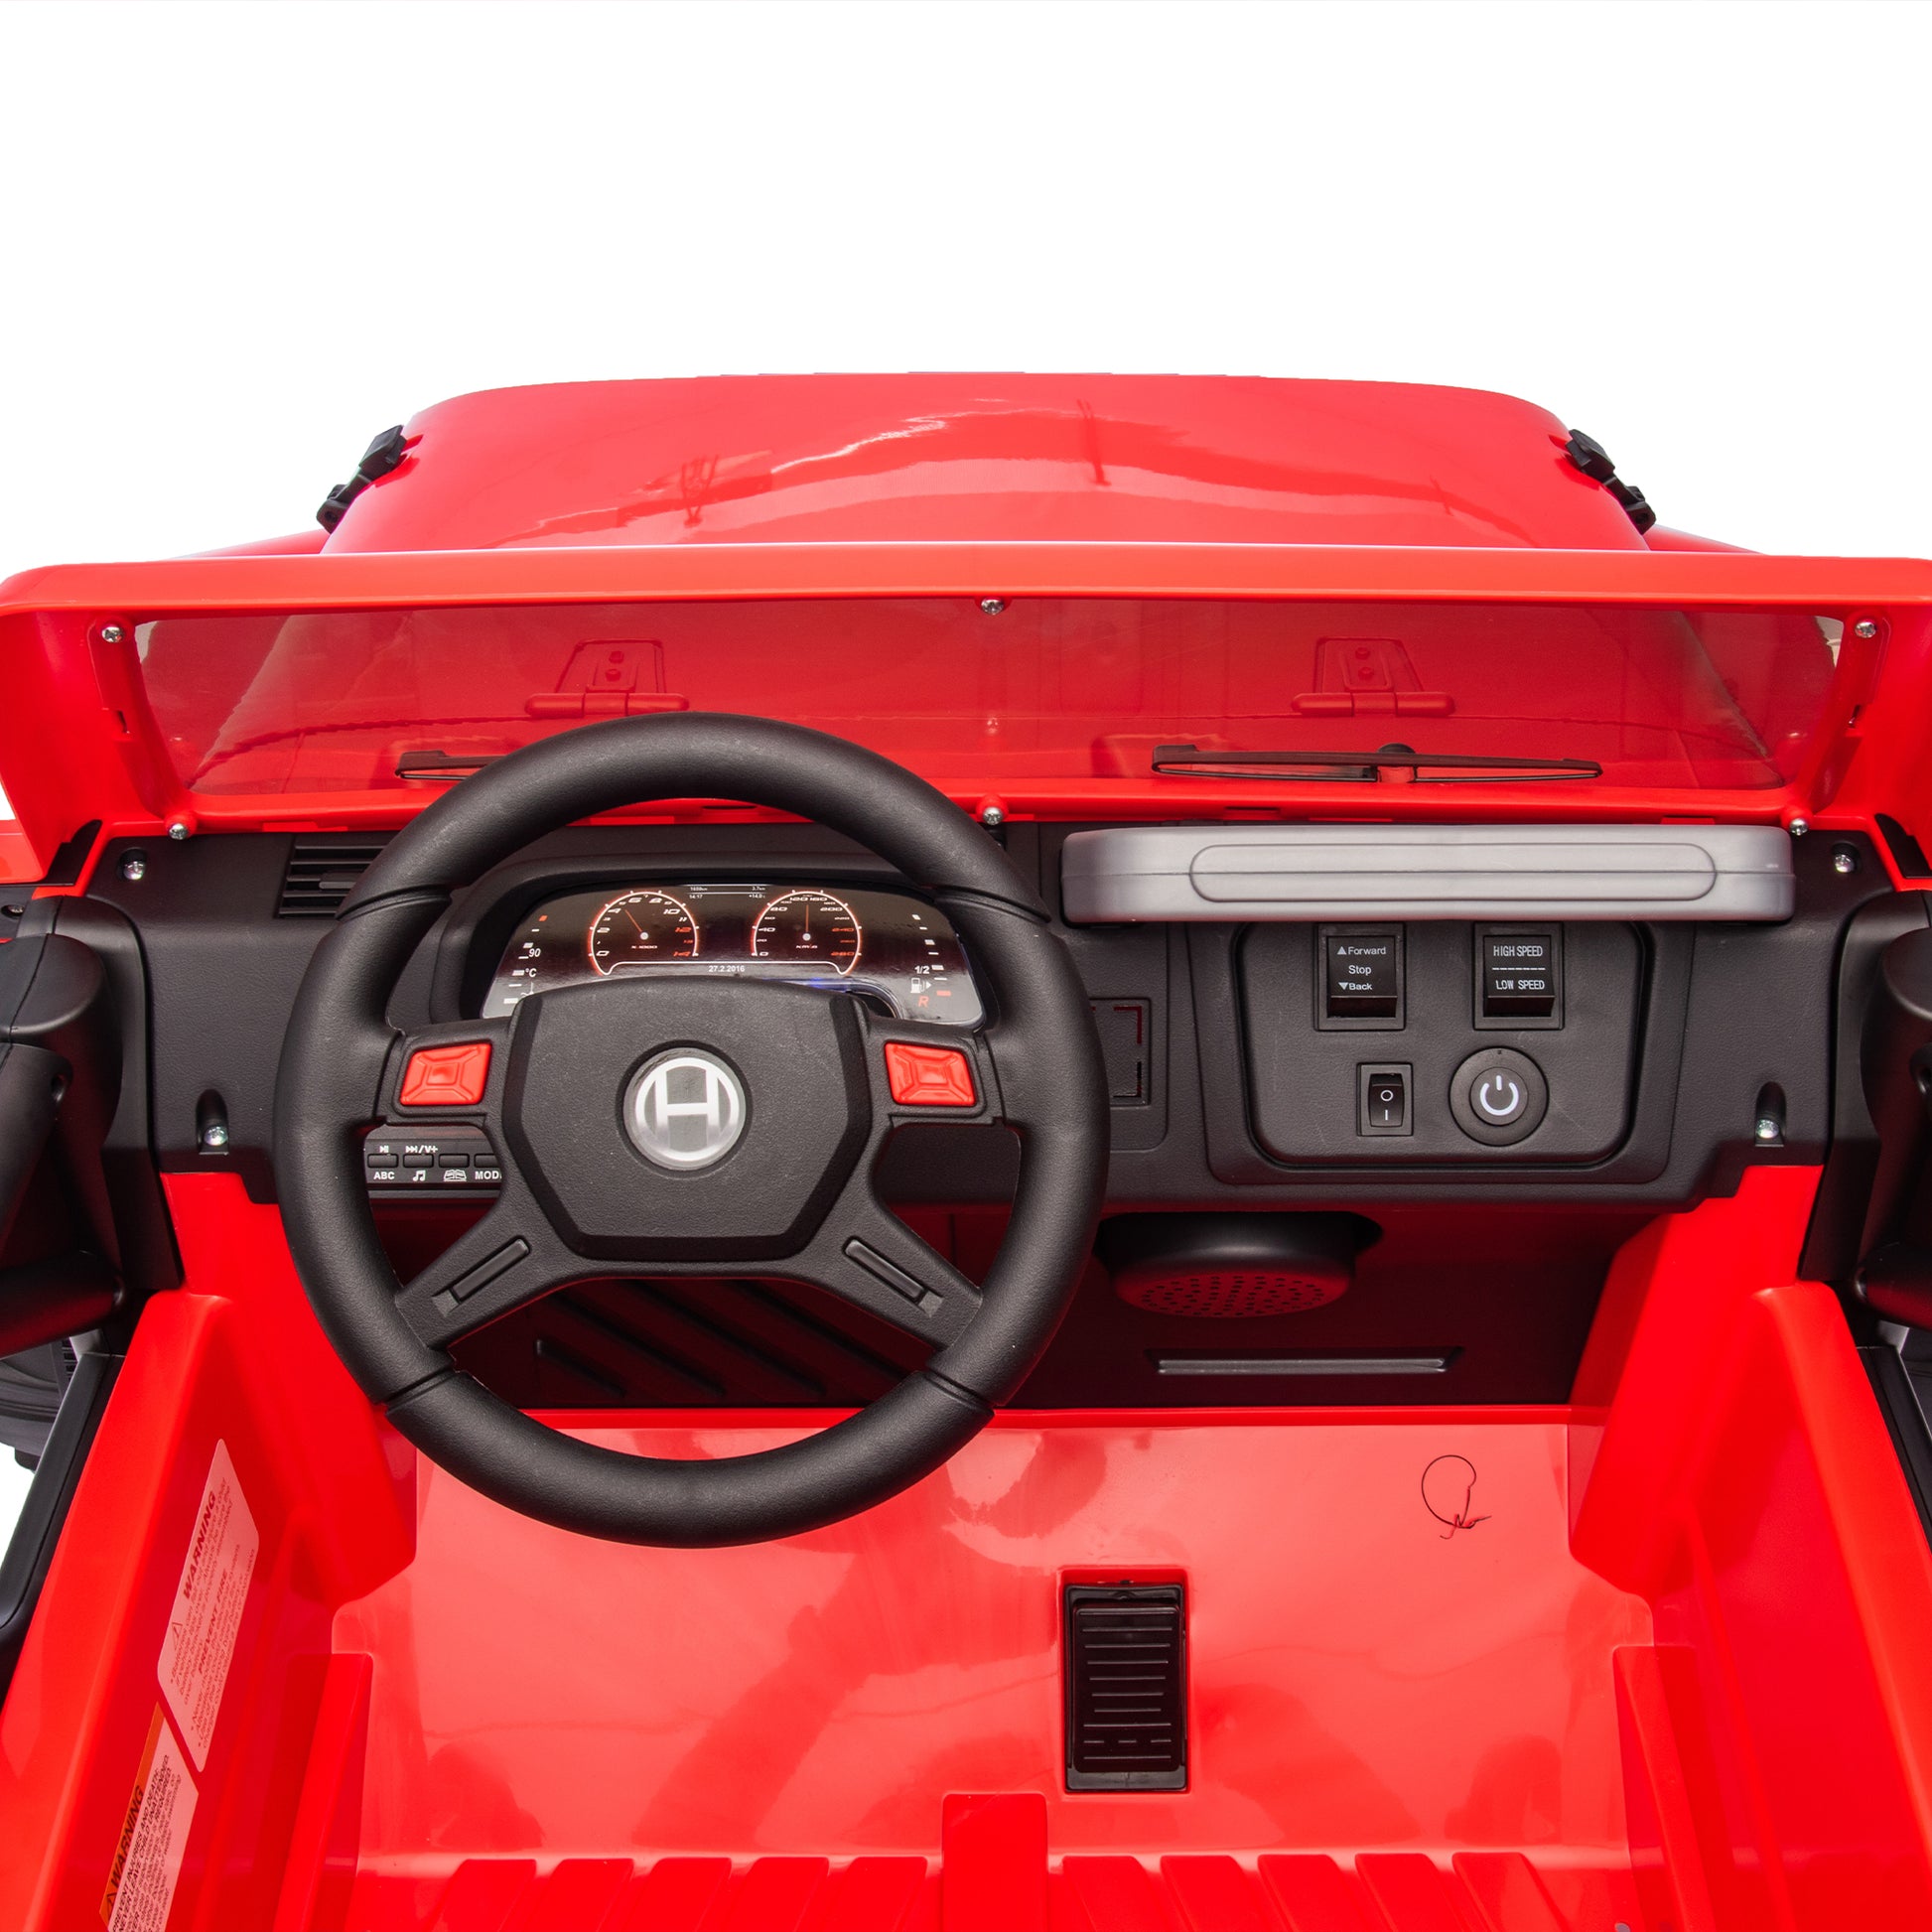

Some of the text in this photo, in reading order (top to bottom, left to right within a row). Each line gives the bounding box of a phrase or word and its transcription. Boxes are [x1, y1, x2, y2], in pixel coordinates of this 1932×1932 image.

[528, 947, 541, 958] 90
[1347, 946, 1387, 956] Forward
[1493, 945, 1544, 957] HIGH SPEED
[524, 967, 537, 978] °C
[708, 964, 746, 973] 27.2.2016
[914, 965, 930, 975] 1/2
[1348, 964, 1372, 976] Stop
[1348, 981, 1373, 991] Back
[1496, 979, 1546, 990] LOW SPEED
[917, 996, 929, 1008] R
[373, 1172, 395, 1180] ABC
[183, 1486, 215, 1602] WARNING
[198, 1567, 227, 1675] PREVENT FIRE
[110, 1781, 143, 1892] WARNING
